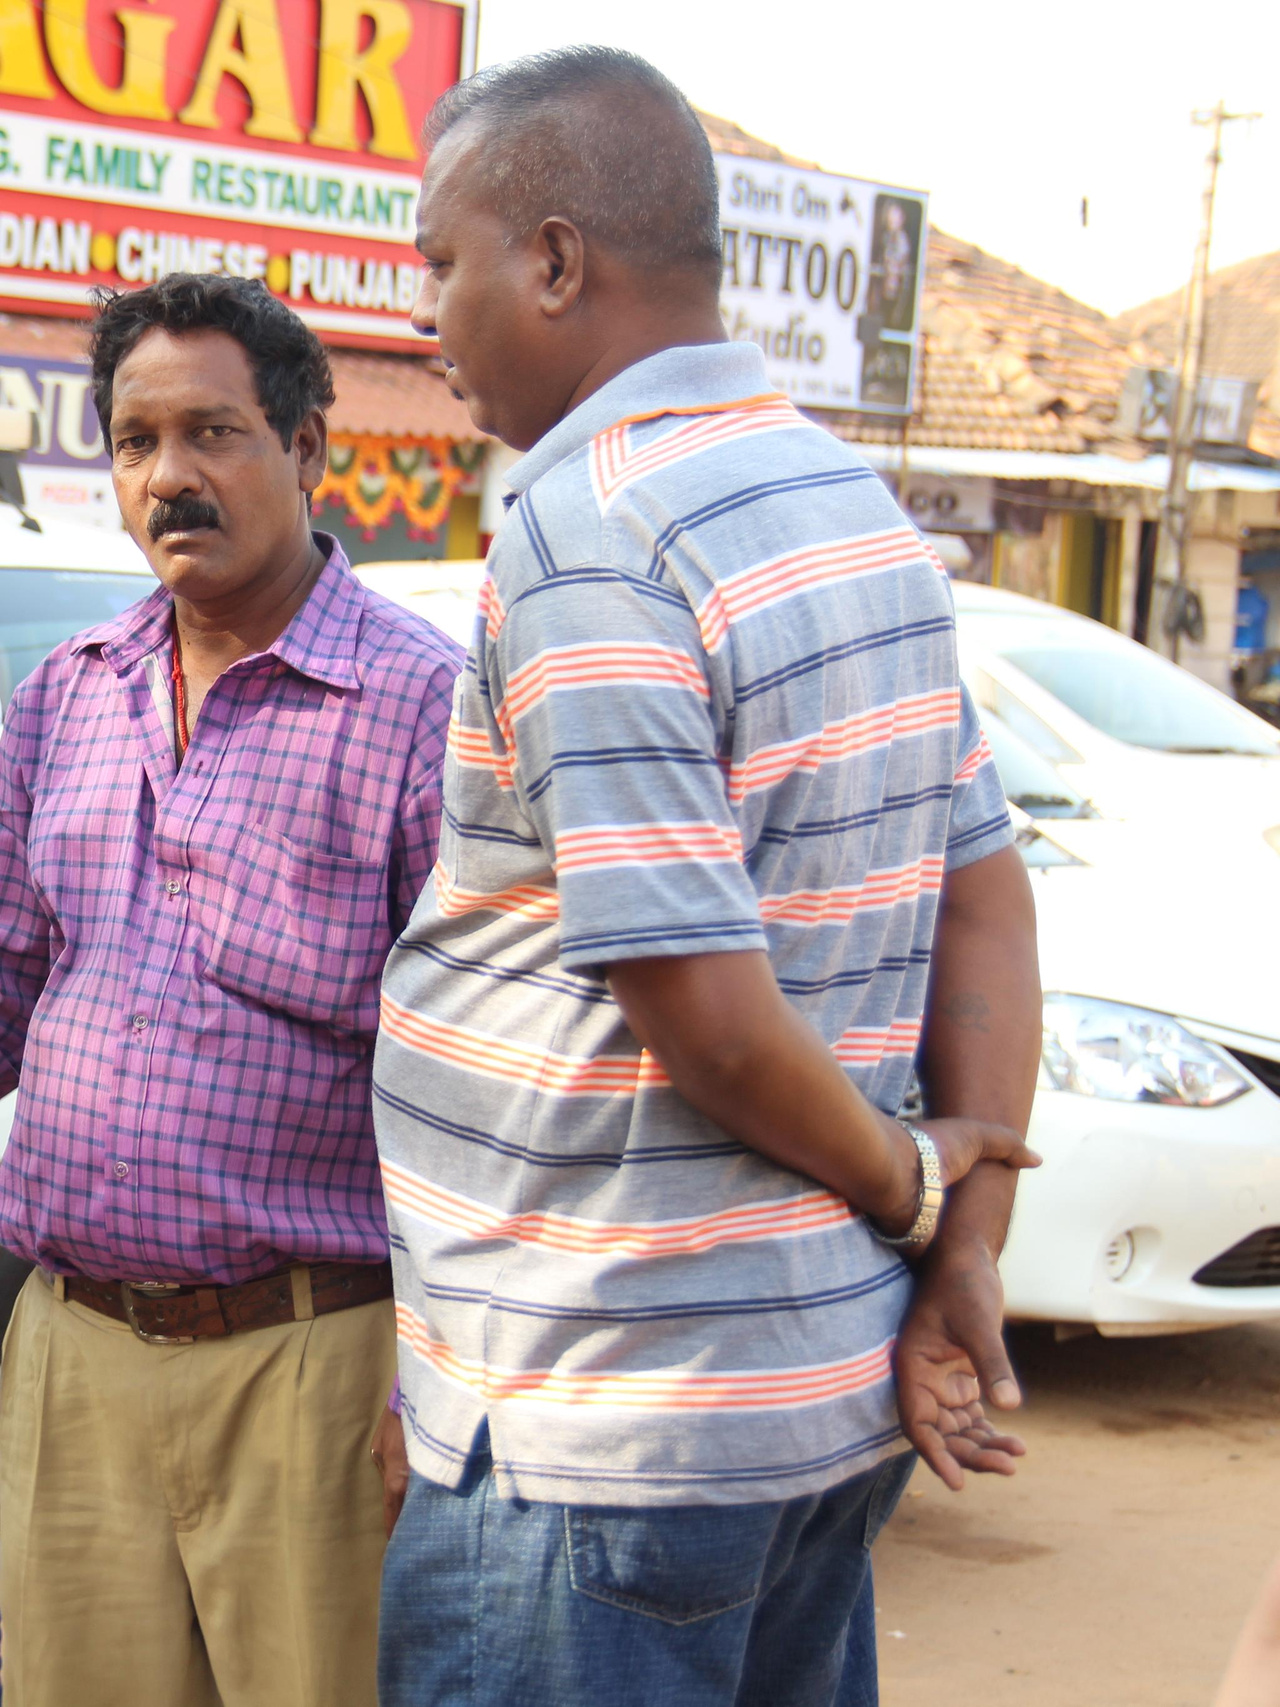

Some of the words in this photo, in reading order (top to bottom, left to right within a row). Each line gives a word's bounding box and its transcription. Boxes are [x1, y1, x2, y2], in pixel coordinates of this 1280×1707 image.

[46, 136, 170, 195] FAMILY
[191, 158, 416, 231] RESTAURANT
[729, 170, 784, 215] Shri
[116, 226, 268, 283] CHINESE
[720, 308, 827, 364] tudio
